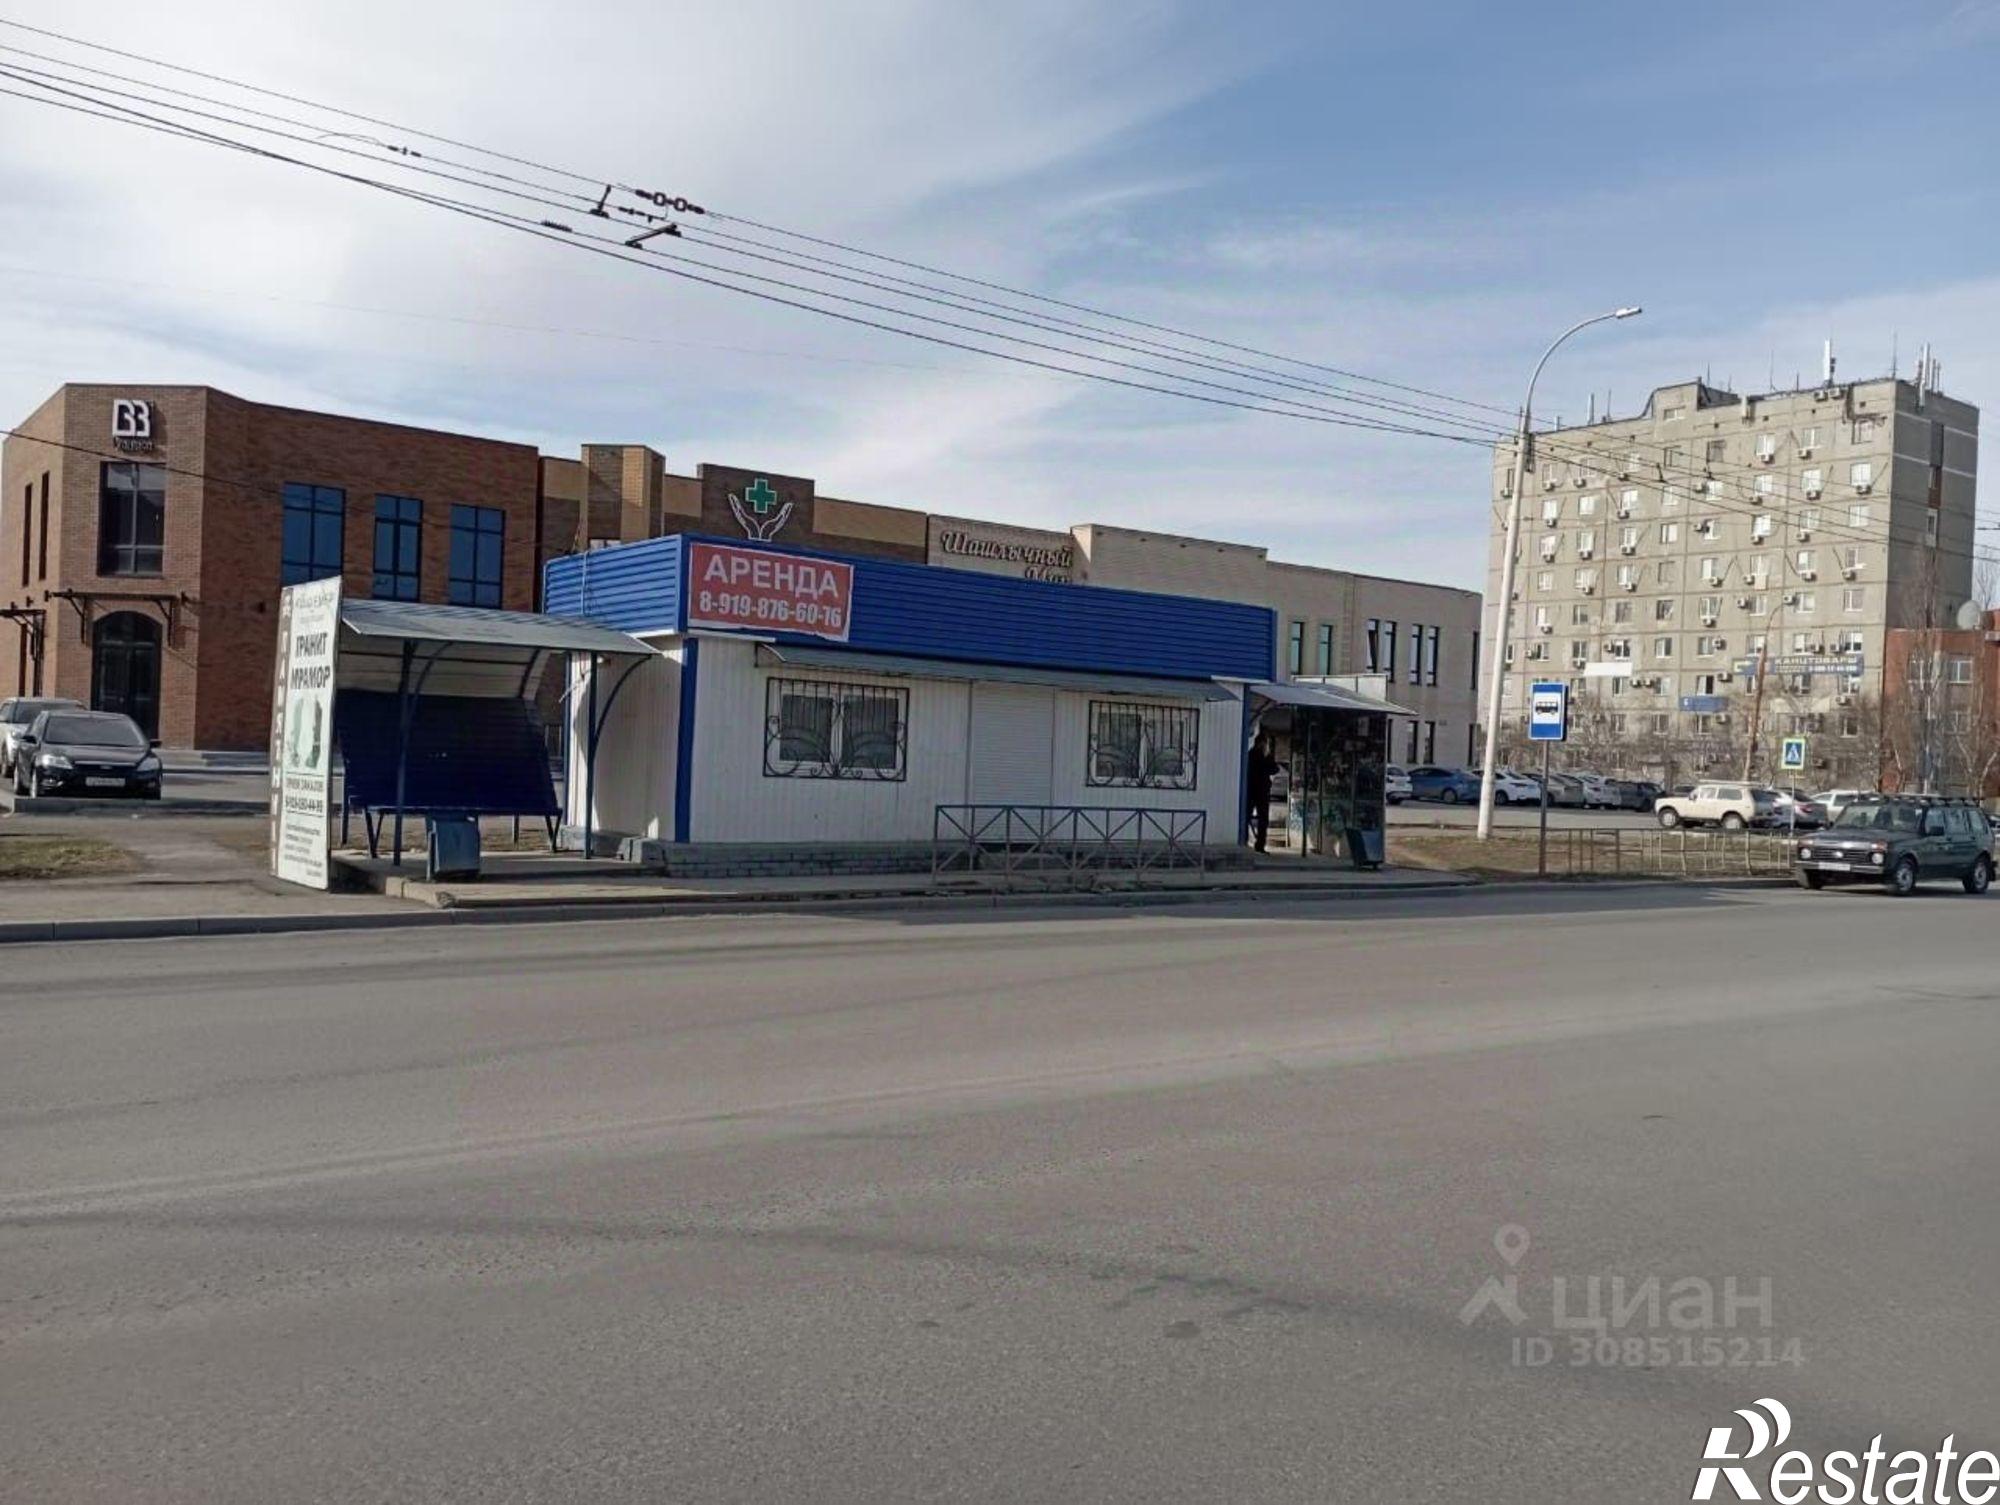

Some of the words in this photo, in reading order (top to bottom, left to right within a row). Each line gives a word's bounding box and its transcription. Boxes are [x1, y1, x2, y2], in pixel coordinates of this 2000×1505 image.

[941, 530, 1072, 568] Шашлычный
[703, 554, 839, 600] АРЕНДА
[699, 590, 842, 627] 8-919-876-60-76
[296, 632, 328, 657] ГРАНИТ
[291, 665, 331, 689] МРАМОР
